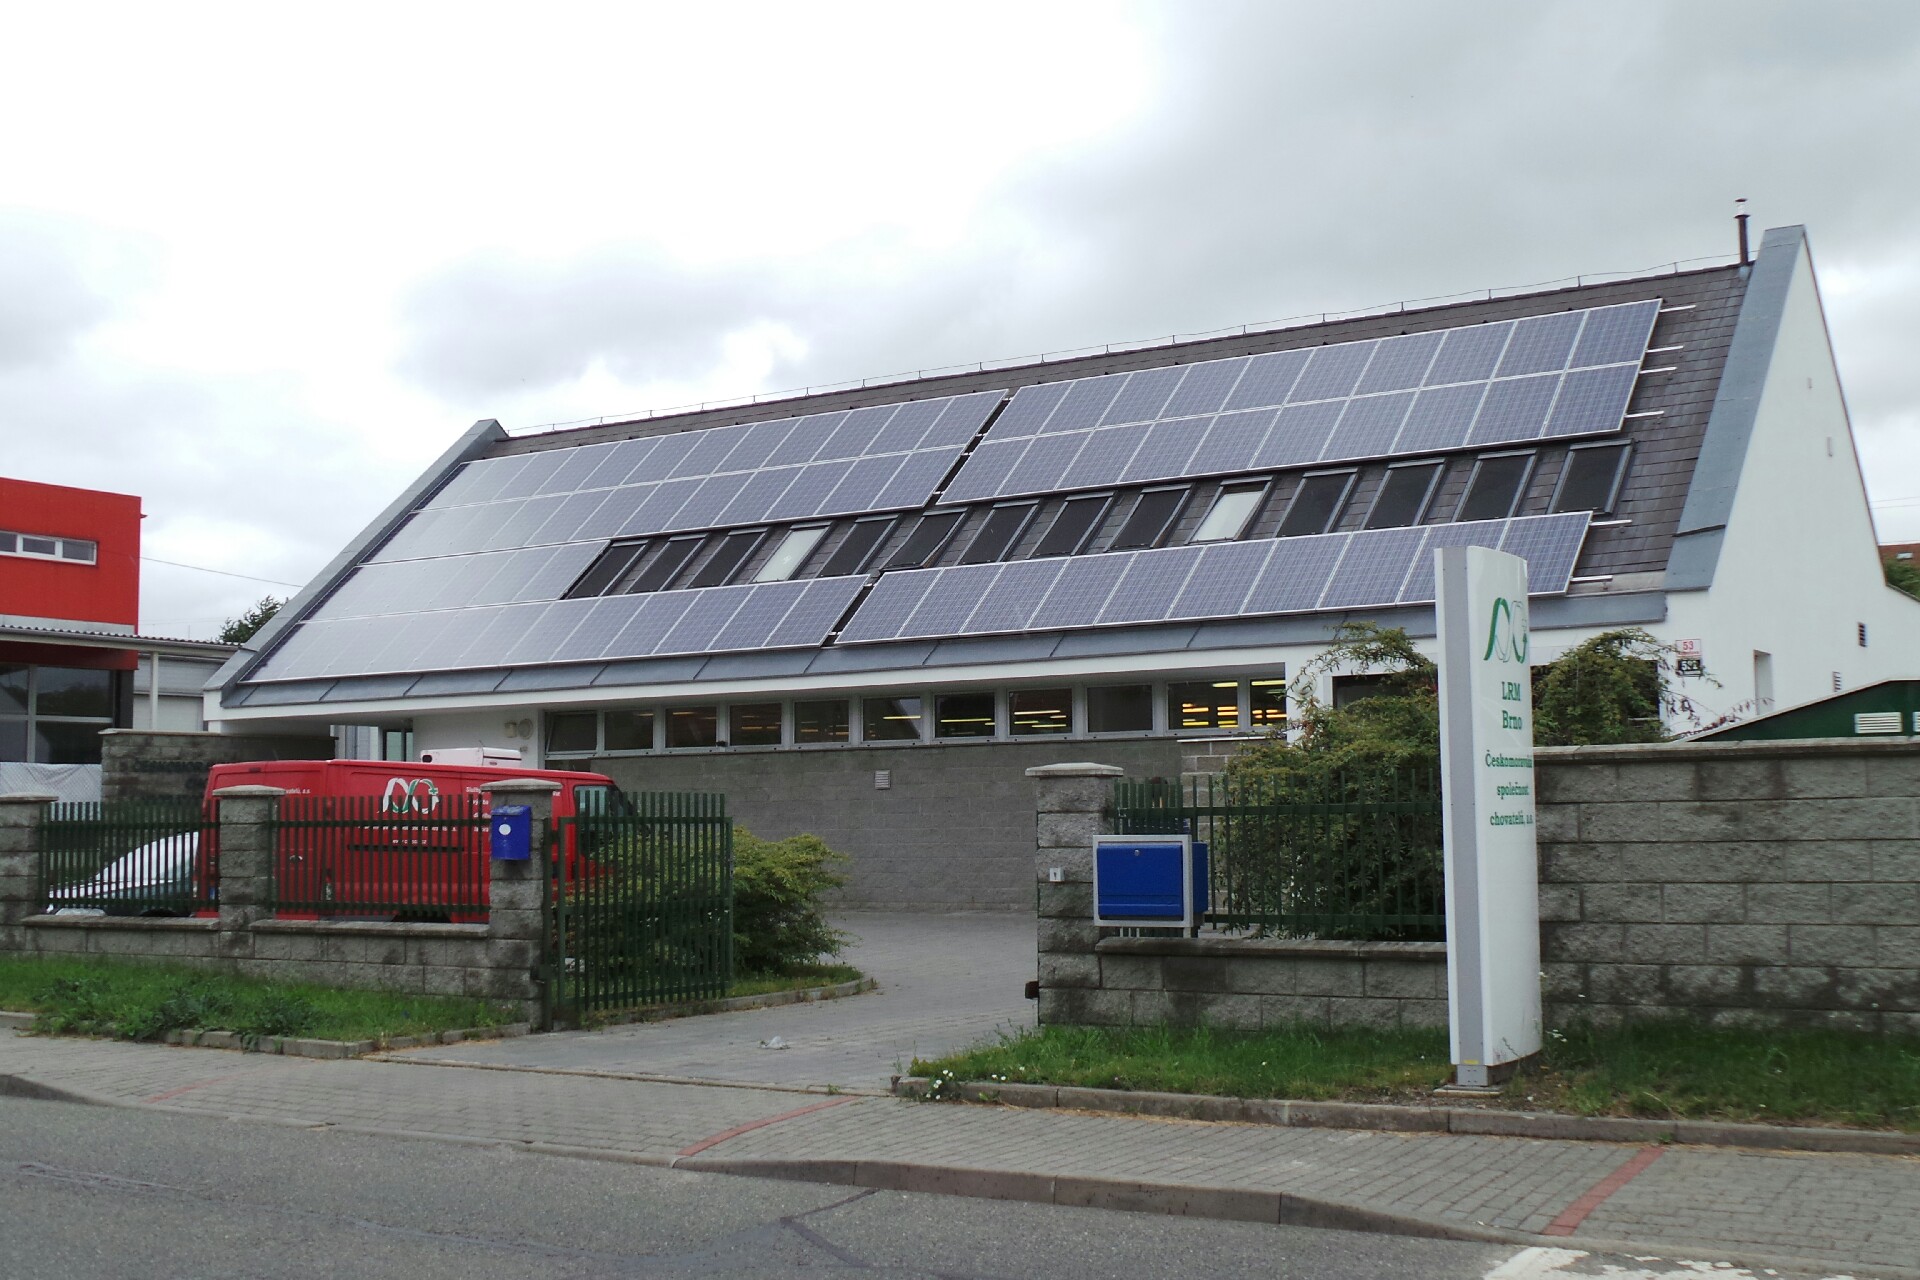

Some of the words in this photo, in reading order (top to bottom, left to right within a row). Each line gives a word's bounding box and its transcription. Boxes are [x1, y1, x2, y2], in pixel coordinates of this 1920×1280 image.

[1683, 640, 1693, 650] 53
[1501, 681, 1521, 701] LRM
[1502, 709, 1522, 730] Brno
